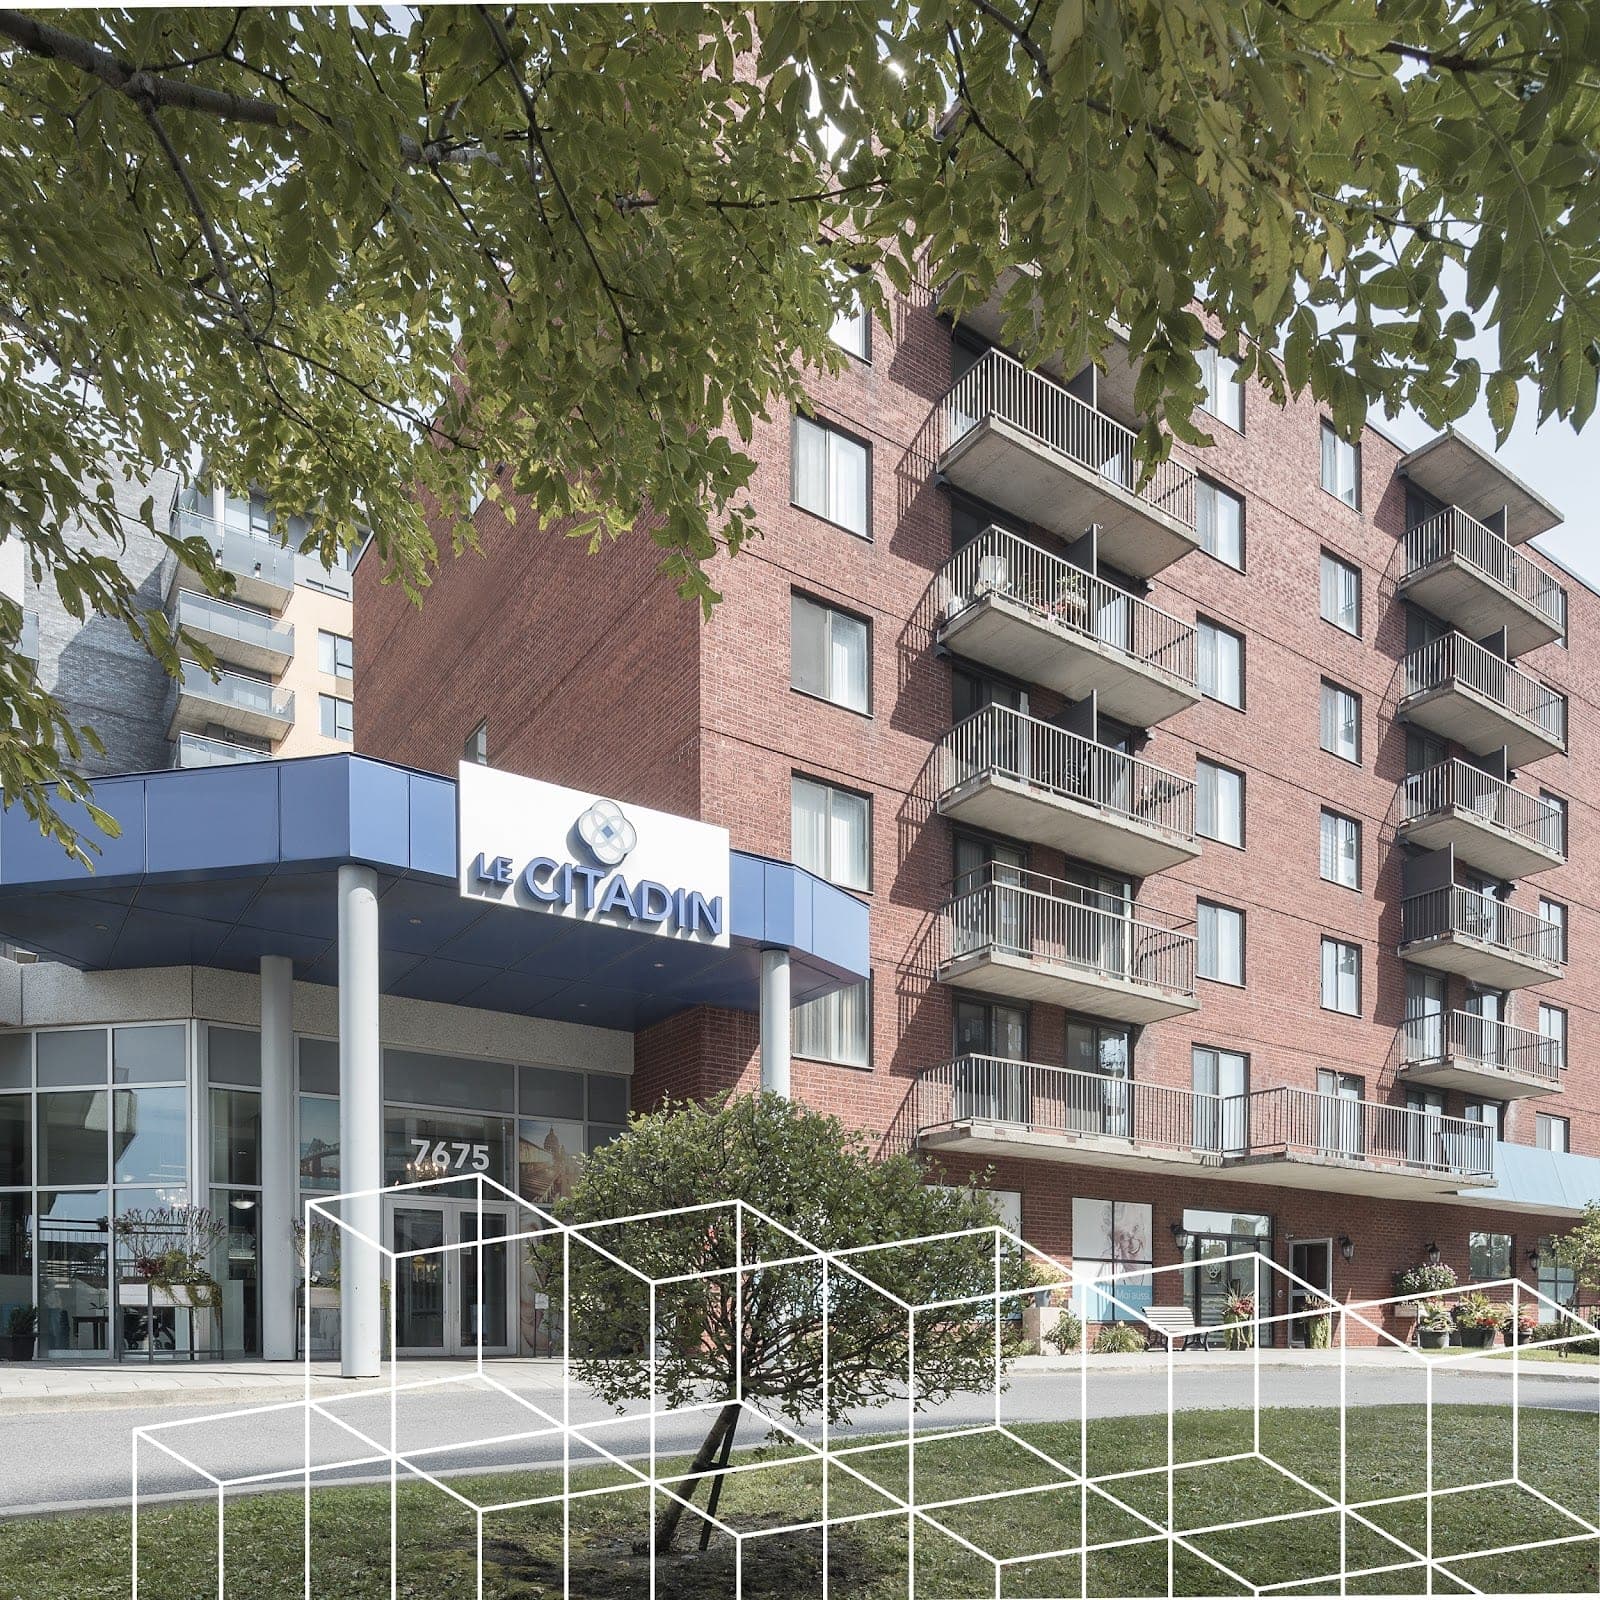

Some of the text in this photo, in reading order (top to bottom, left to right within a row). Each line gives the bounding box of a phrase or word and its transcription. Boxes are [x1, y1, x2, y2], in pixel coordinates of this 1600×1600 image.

[477, 852, 723, 934] LE CITADIN
[410, 1138, 490, 1171] 7675
